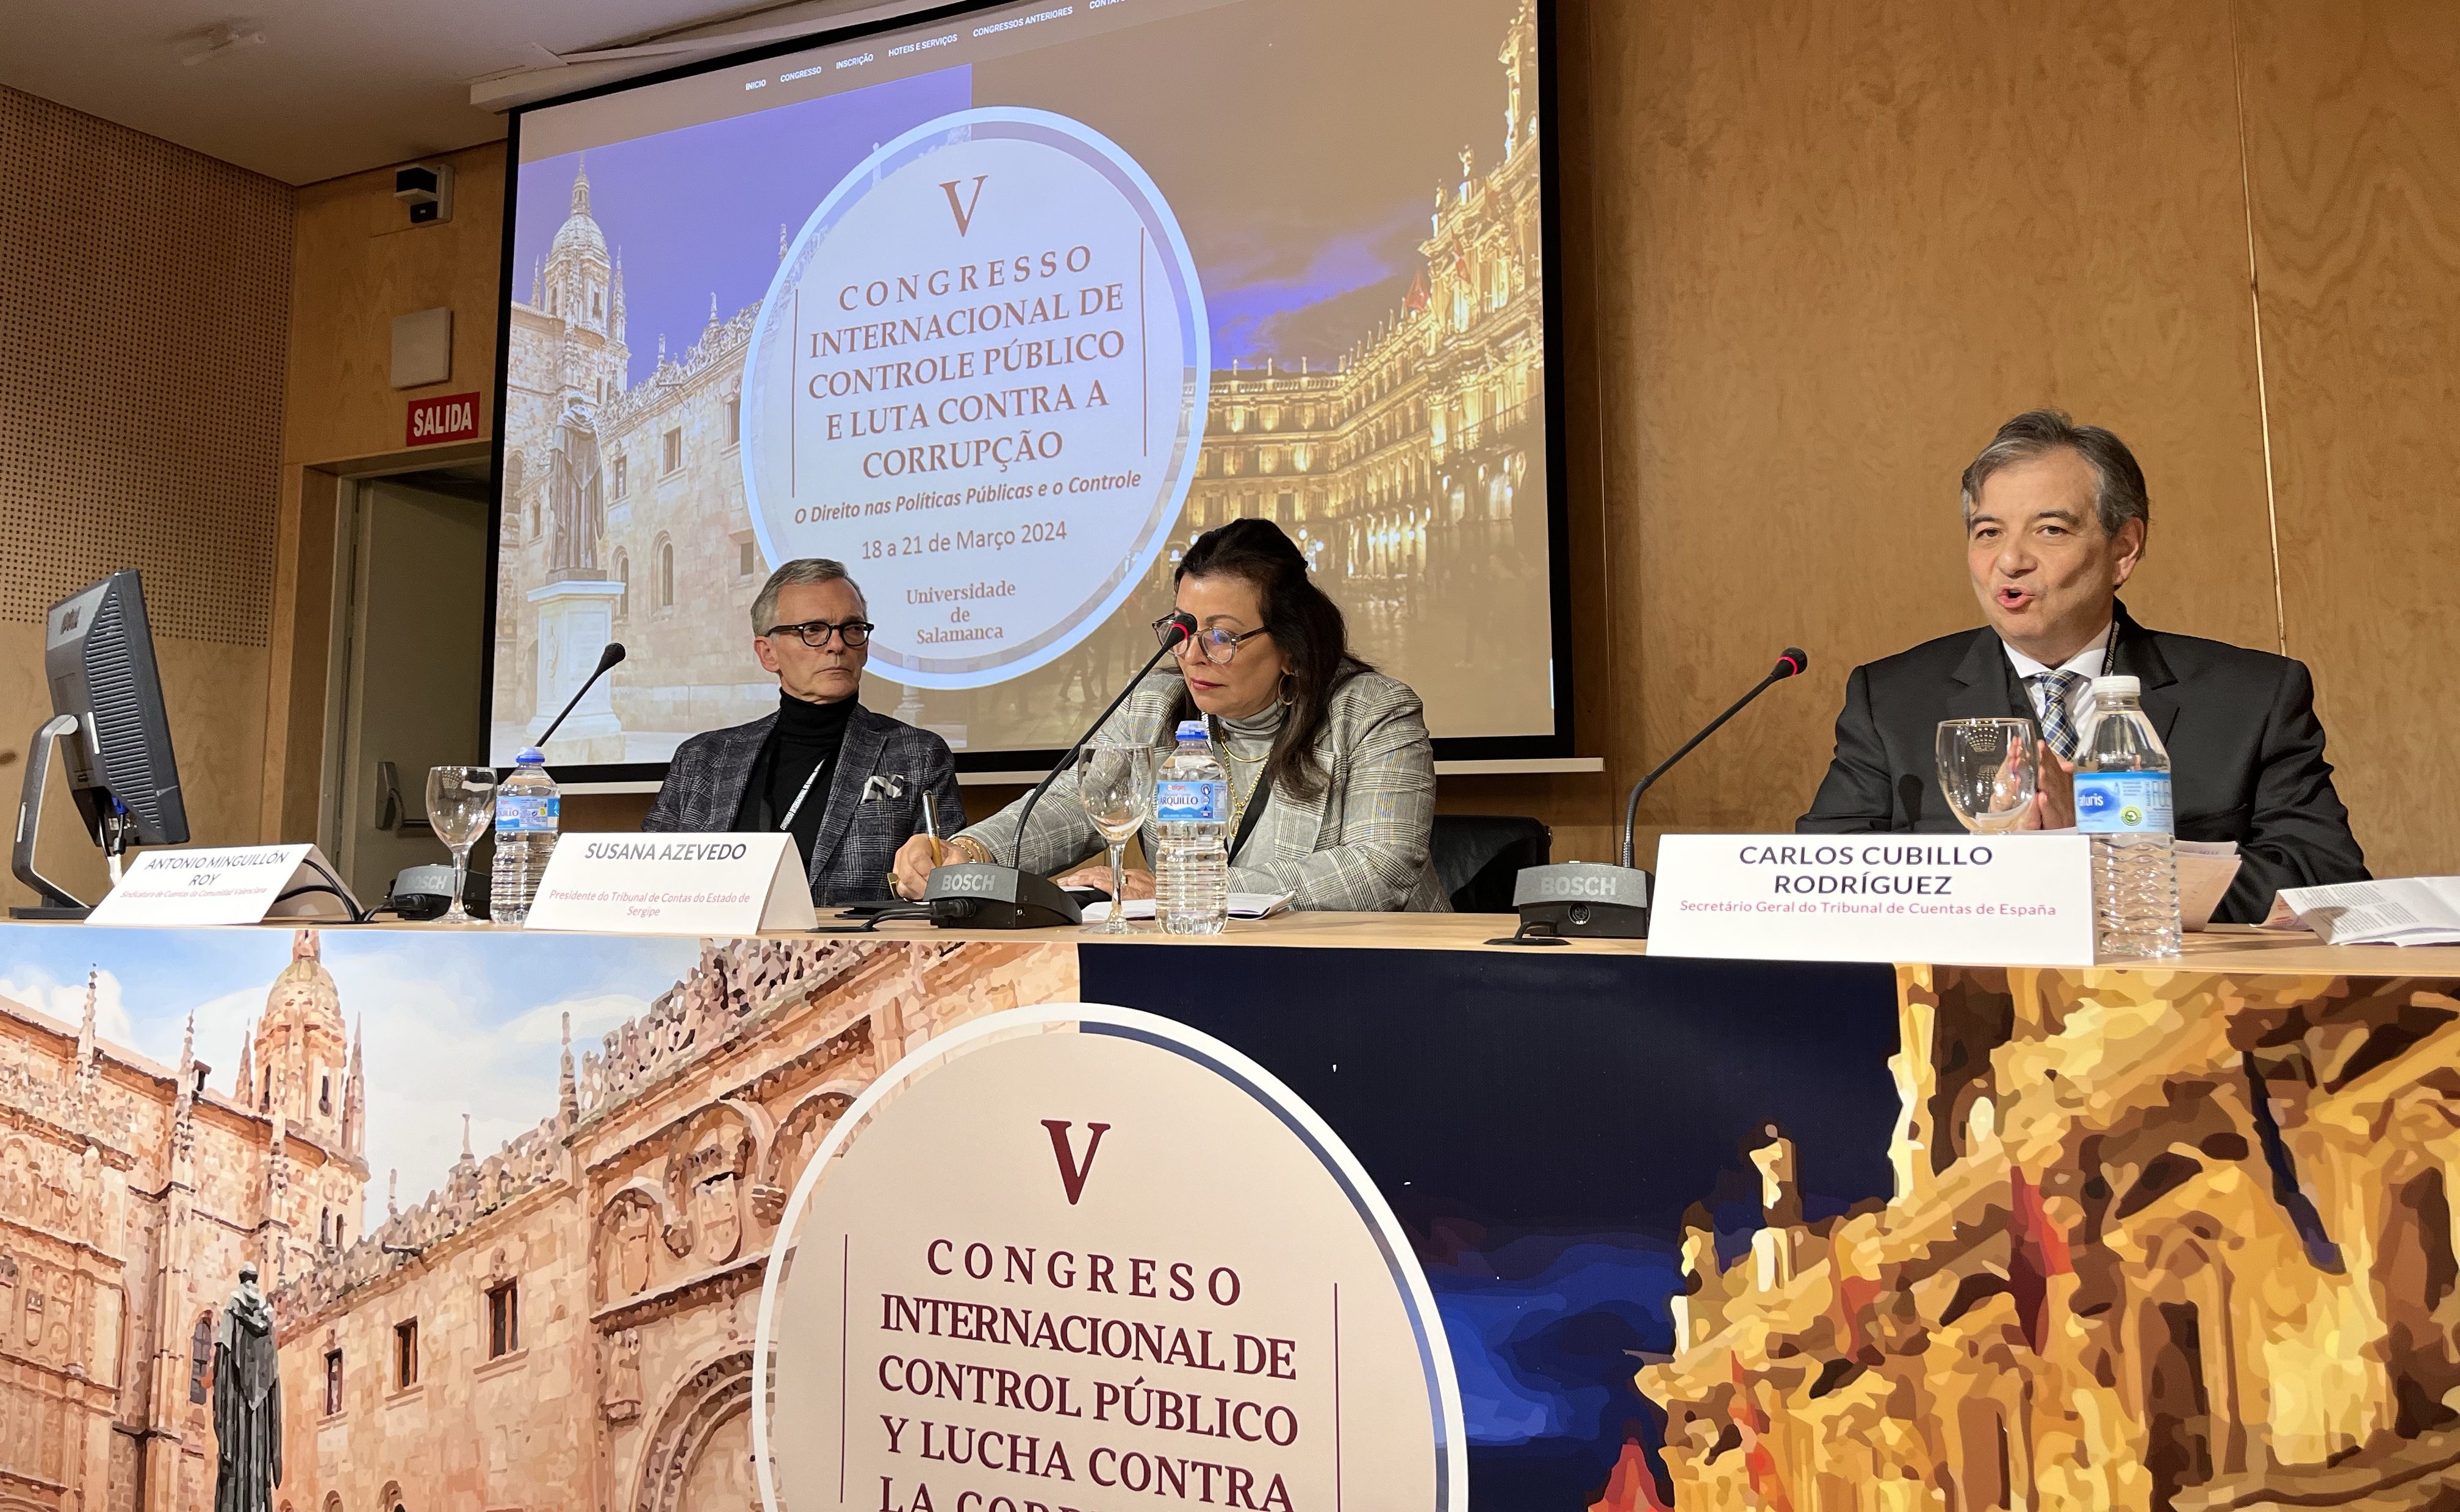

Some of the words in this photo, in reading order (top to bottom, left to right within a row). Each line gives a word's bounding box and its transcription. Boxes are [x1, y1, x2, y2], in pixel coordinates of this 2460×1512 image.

[973, 18, 1023, 37] CONGRESSOS
[1024, 7, 1073, 26] ANTERIORES
[888, 43, 915, 57] HOTEIS
[922, 34, 957, 51] SERVIÇOS
[836, 53, 873, 70] INSCRIÇÃO
[746, 79, 766, 91] INICIO
[780, 66, 821, 83] CONGRESSO
[939, 174, 988, 237] V
[840, 245, 1091, 310] CONGRESSO
[810, 293, 1069, 358] INTERNACIONAL
[1079, 284, 1124, 316] DE
[808, 352, 974, 399] CONTROLE
[982, 330, 1124, 375] PÚBLICO
[413, 402, 472, 437] SALIDA
[826, 414, 842, 440] E
[851, 403, 929, 438] LUTA
[938, 384, 1074, 425] CONTRA
[1086, 379, 1109, 407] A
[863, 429, 1063, 478] CORRUPÇÃO
[794, 509, 807, 524] O
[811, 503, 860, 522] Direito
[865, 501, 891, 515] nas
[896, 490, 961, 512] Políticas
[966, 482, 1032, 504] Públicas
[1038, 484, 1047, 496] e
[1053, 482, 1062, 495] o
[1068, 470, 1141, 493] Controle
[862, 540, 881, 559] 18
[887, 543, 896, 557] a
[902, 536, 922, 555] 21
[929, 532, 951, 553] de
[957, 528, 1015, 551] Março
[1021, 521, 1066, 543] 2024
[907, 580, 1015, 604] Universidade
[951, 606, 970, 623] de
[916, 626, 1003, 644] Salamanca
[2079, 793, 2104, 806] aturis
[145, 855, 207, 870] ANTONIO
[206, 850, 289, 869] MINGUILLÓN
[585, 843, 656, 860] SUSANA
[660, 843, 747, 860] AZEVEDO
[1739, 846, 1854, 865] CARLOS
[1861, 846, 1993, 865] CUBILLO
[189, 873, 221, 886] ROY
[941, 875, 996, 892] BOSCH
[1541, 877, 1616, 896] BOSCH
[1774, 872, 1952, 895] RODRÍGUEZ
[549, 889, 596, 901] Presidente
[598, 891, 608, 901] do
[611, 891, 647, 903] Tribunal
[649, 892, 660, 903] de
[661, 892, 692, 903] Contas
[693, 892, 705, 903] do
[707, 892, 736, 903] Estado
[738, 892, 750, 903] de
[627, 906, 660, 918] Sergipe
[1680, 900, 1752, 913] Secretário
[1756, 900, 1794, 914] Geral
[1798, 901, 1817, 914] do
[1821, 901, 1882, 915] Tribunal
[1886, 901, 1904, 915] de
[1908, 902, 1971, 915] Cuentas
[1975, 903, 1995, 916] de
[1999, 903, 2056, 917] España
[1041, 1119, 1110, 1205] V
[927, 1239, 1241, 1306] CONGRESO
[880, 1294, 1225, 1371] INTERNACIONAL
[1232, 1333, 1297, 1380] DE
[879, 1355, 1082, 1418] CONTROL
[1093, 1375, 1298, 1447] PÚBLICO
[880, 1414, 908, 1453] Y
[919, 1422, 1075, 1482] LUCHA
[1089, 1447, 1295, 1512] CONTRA
[879, 1476, 933, 1512] LA
